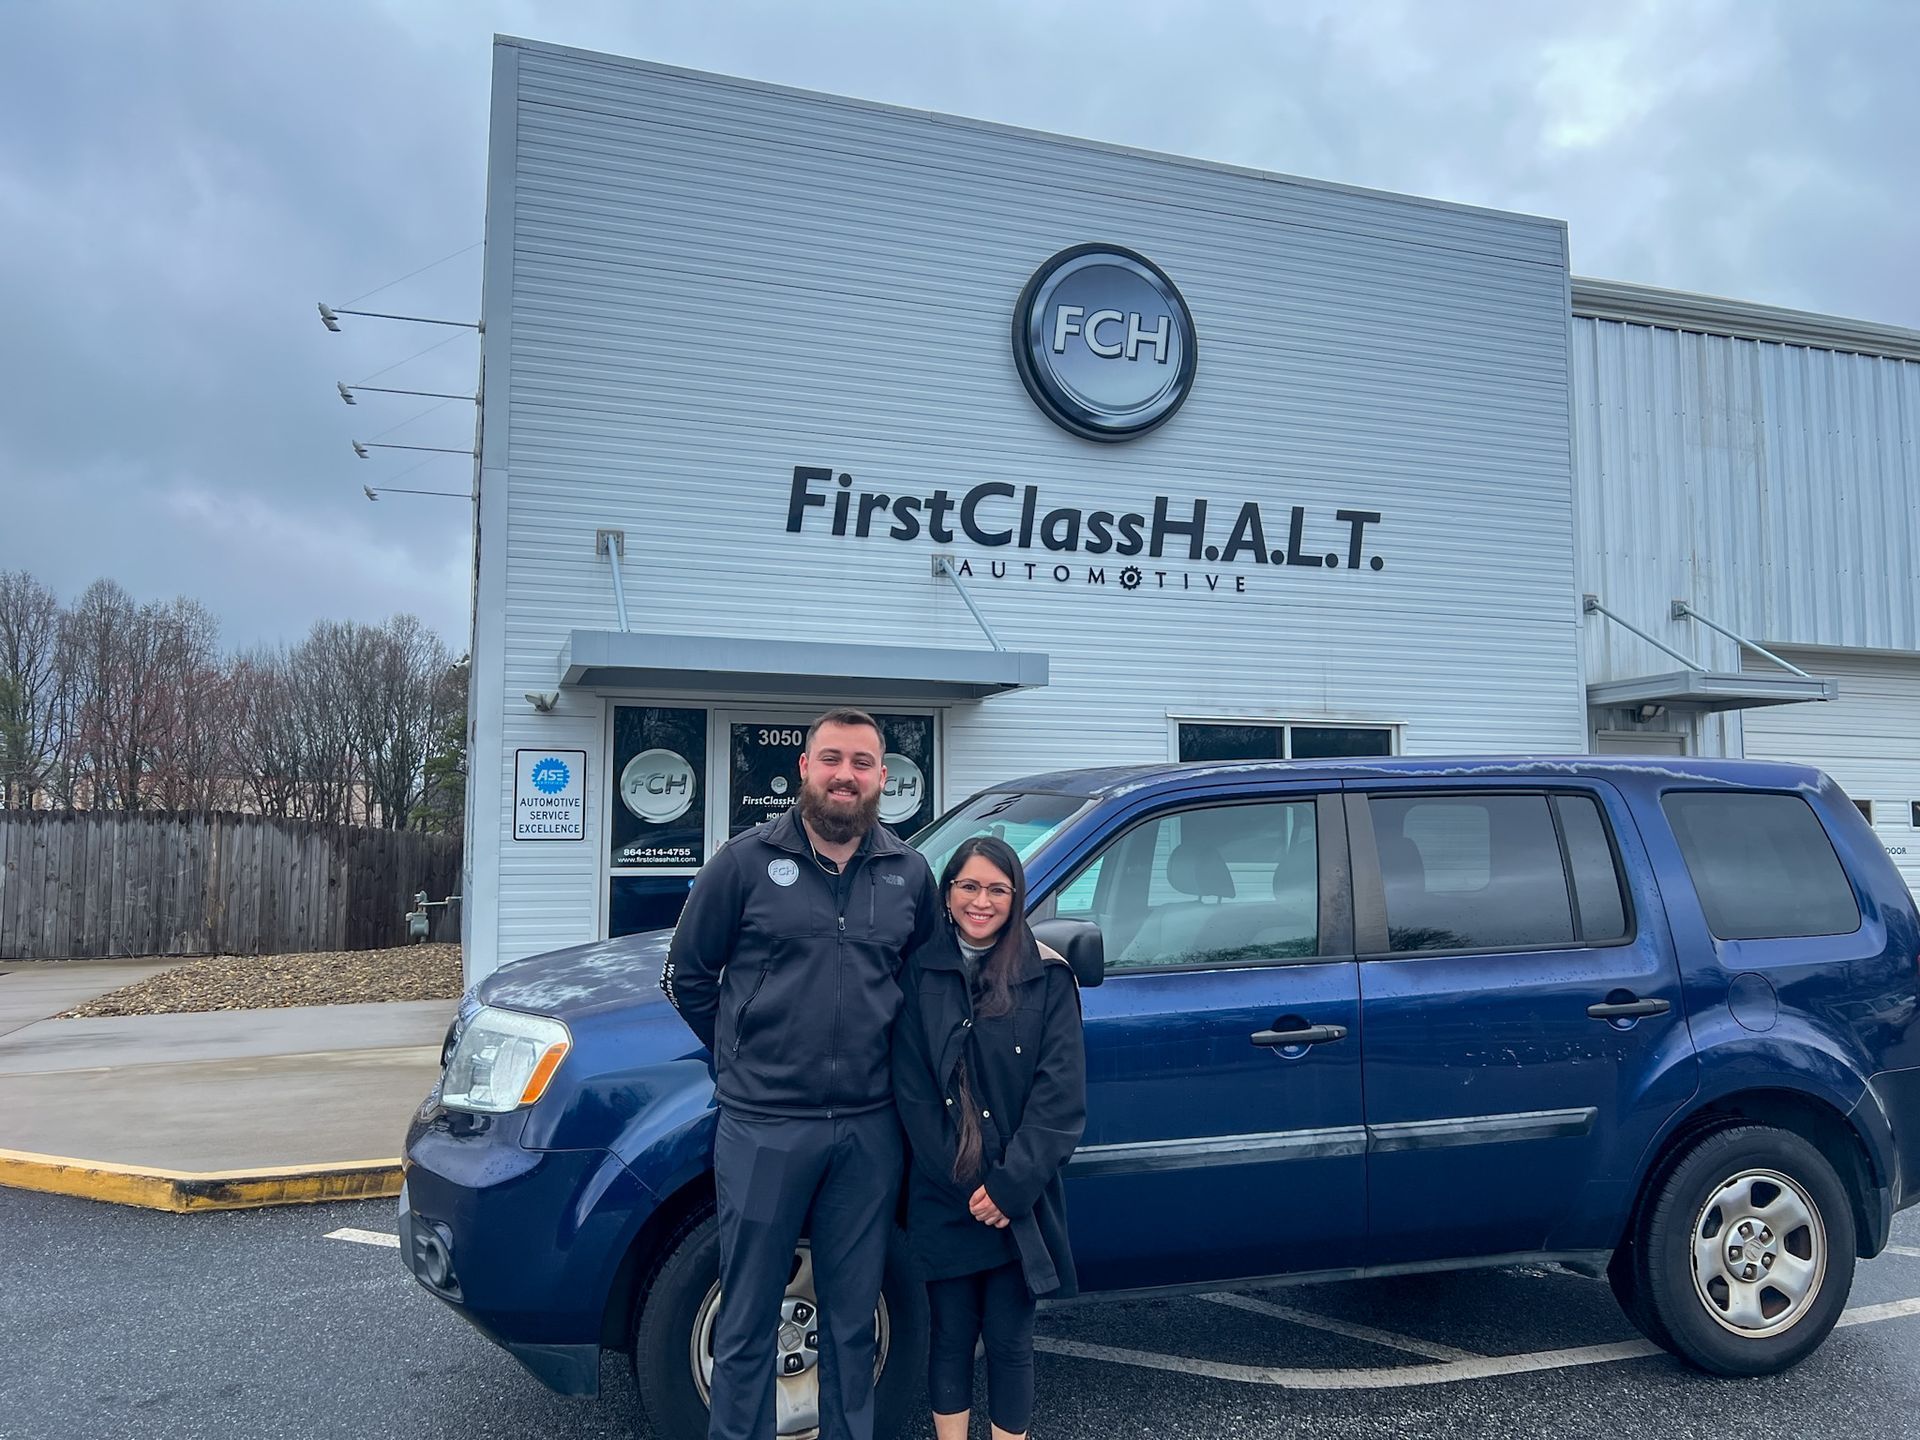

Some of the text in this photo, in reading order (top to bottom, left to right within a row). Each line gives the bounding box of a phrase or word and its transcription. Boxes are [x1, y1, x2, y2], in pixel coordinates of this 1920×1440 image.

[1052, 304, 1172, 364] FCH
[958, 559, 1246, 592] AUTOMOTIVE
[758, 729, 802, 746] 3050
[537, 769, 564, 781] ASE
[630, 772, 688, 795] FCH
[882, 776, 917, 796] CH
[520, 798, 580, 807] AUTOMOTIVE
[530, 811, 570, 820] SERVICE
[519, 824, 580, 833] EXCELLENCE
[623, 848, 691, 856] 864-214-4755
